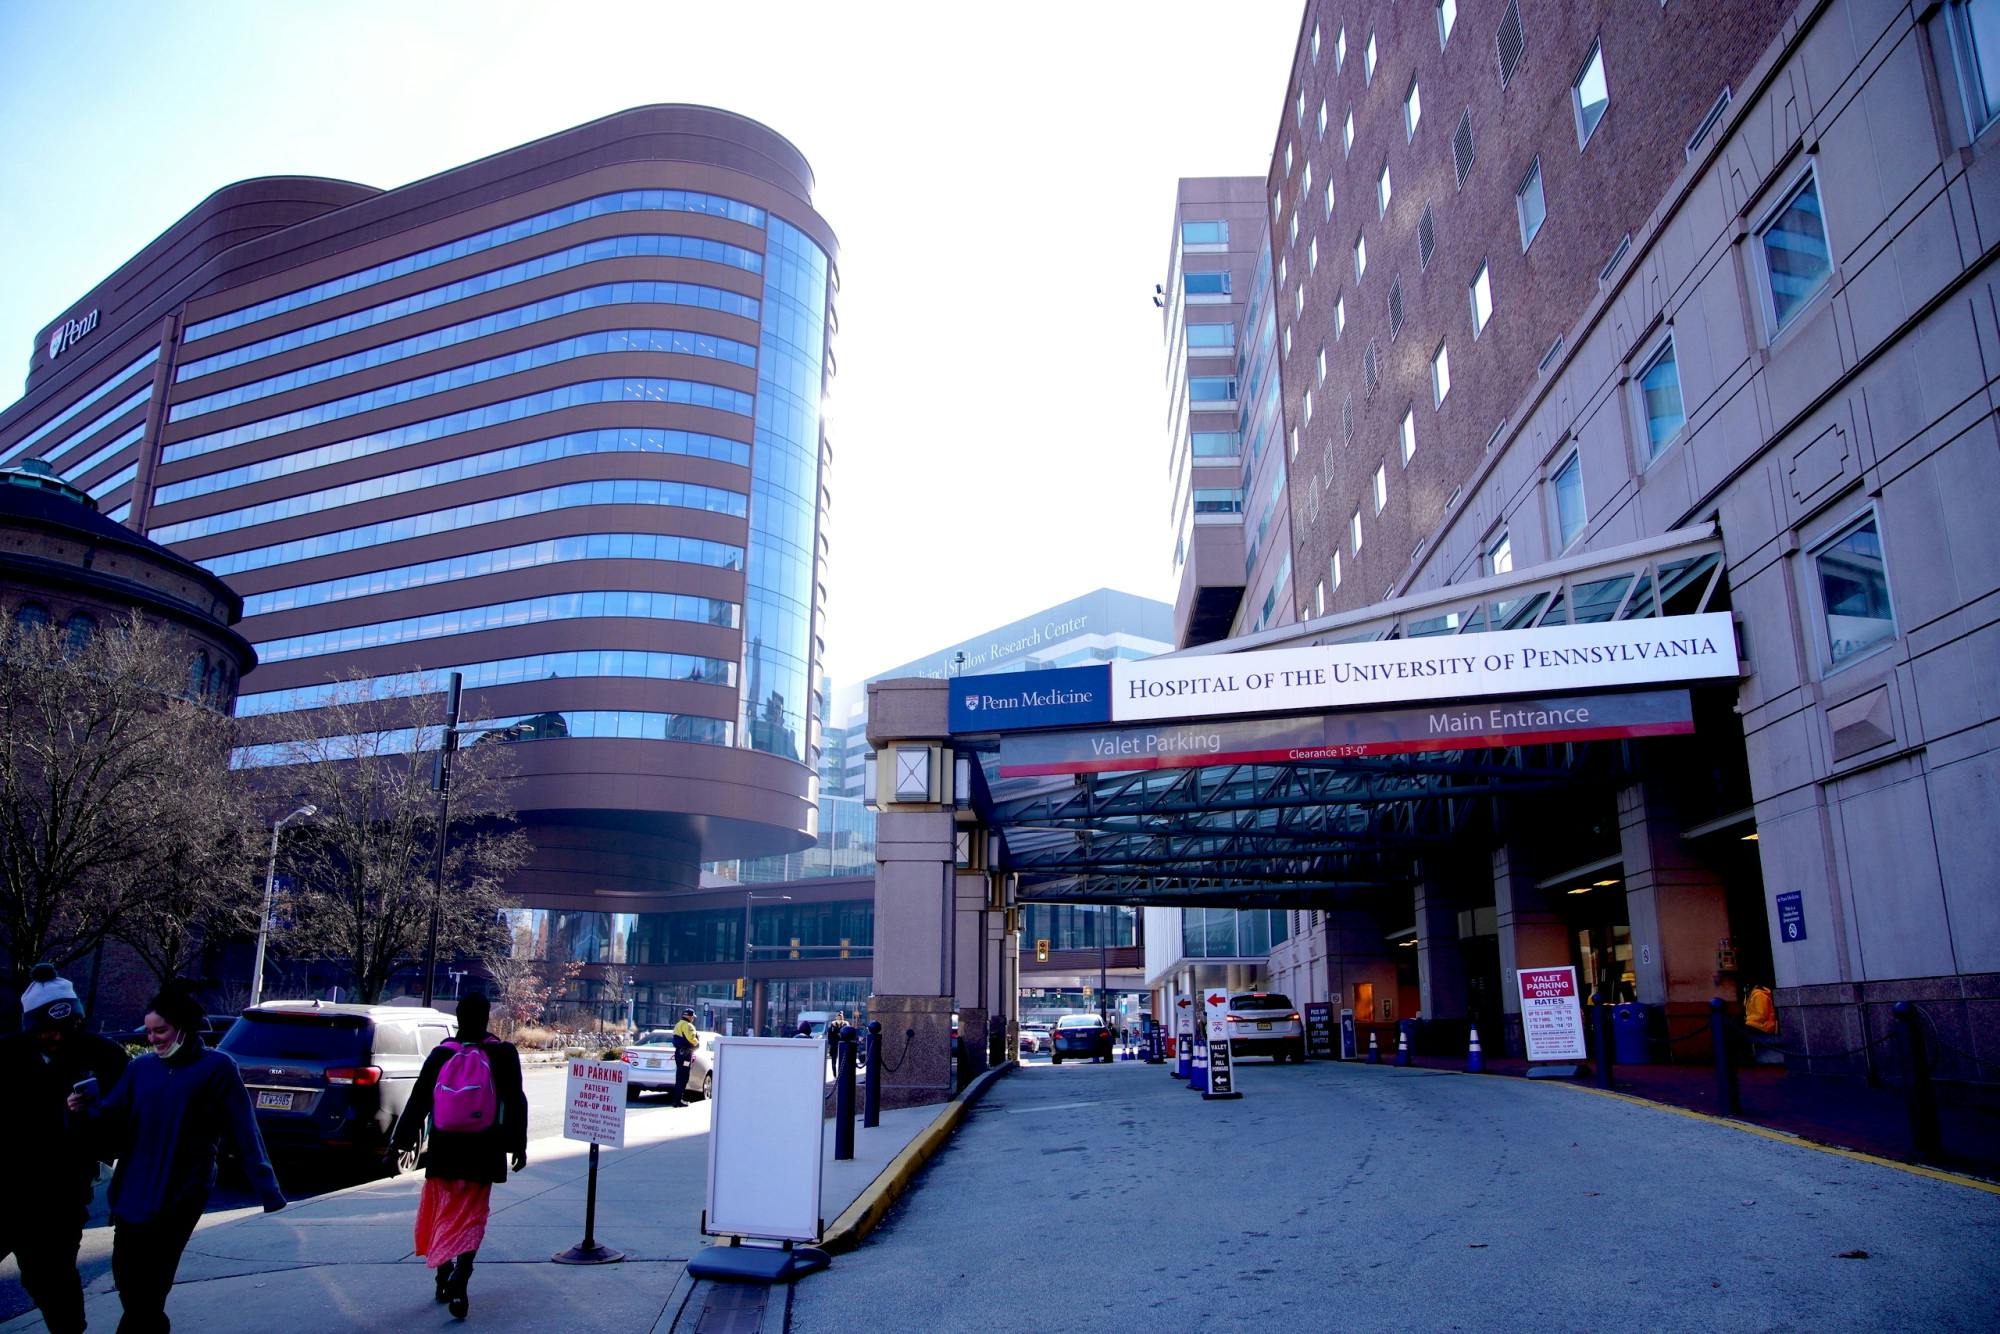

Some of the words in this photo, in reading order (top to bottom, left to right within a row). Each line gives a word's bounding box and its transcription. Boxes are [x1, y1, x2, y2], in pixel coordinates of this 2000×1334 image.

[60, 309, 98, 352] Penn
[991, 627, 1041, 661] Research
[1044, 615, 1088, 640] Center
[982, 695, 1019, 710] Penn
[1022, 688, 1093, 708] Medicine
[1429, 712, 1483, 733] Main
[1490, 707, 1590, 729] Entrance
[1091, 736, 1140, 755] Valet
[1146, 731, 1221, 752] Parking
[1289, 747, 1337, 760] Clearance
[1531, 974, 1561, 982] VALET
[1526, 981, 1569, 991] PARKING
[1536, 989, 1561, 997] ONLY
[573, 1063, 584, 1077] NO
[587, 1066, 623, 1083] PARKING
[584, 1083, 609, 1093] PATIENT
[574, 1099, 600, 1109] PICK-UP
[602, 1103, 617, 1113] ONLY
[581, 1123, 600, 1132] TOWED
[593, 1131, 616, 1141] Expense
